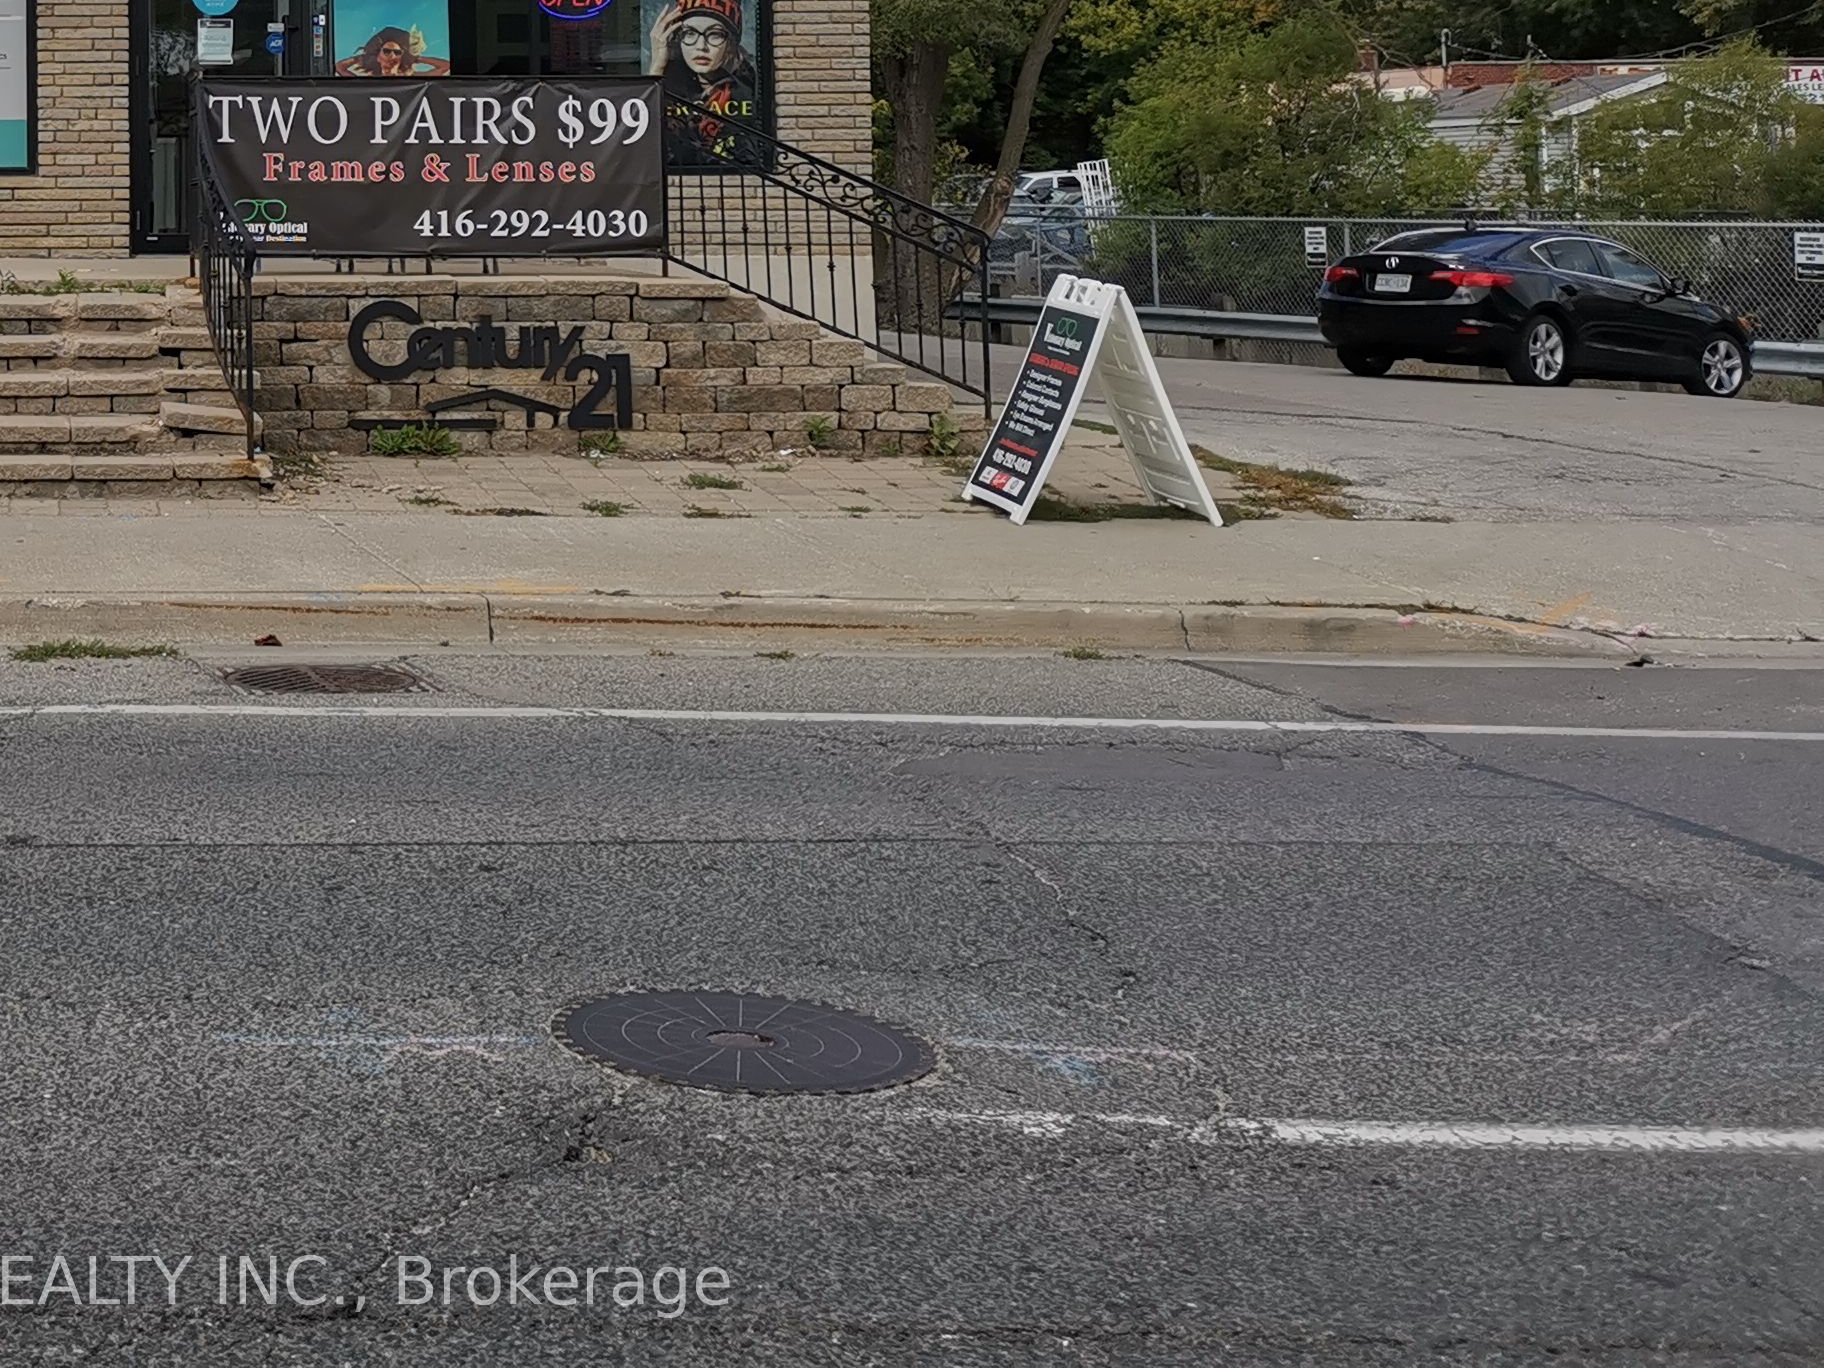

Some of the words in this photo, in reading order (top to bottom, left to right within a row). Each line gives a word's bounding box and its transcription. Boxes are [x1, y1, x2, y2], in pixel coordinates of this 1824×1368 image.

[208, 95, 348, 145] TWO
[369, 95, 537, 145] PAIRS
[557, 94, 650, 150] $99
[262, 151, 406, 183] Frames
[421, 152, 453, 184] &
[465, 151, 596, 183] Lenses
[268, 221, 308, 234] Optical
[412, 207, 649, 240] 416-292-4030
[347, 299, 586, 382] Century
[564, 354, 633, 430] 21
